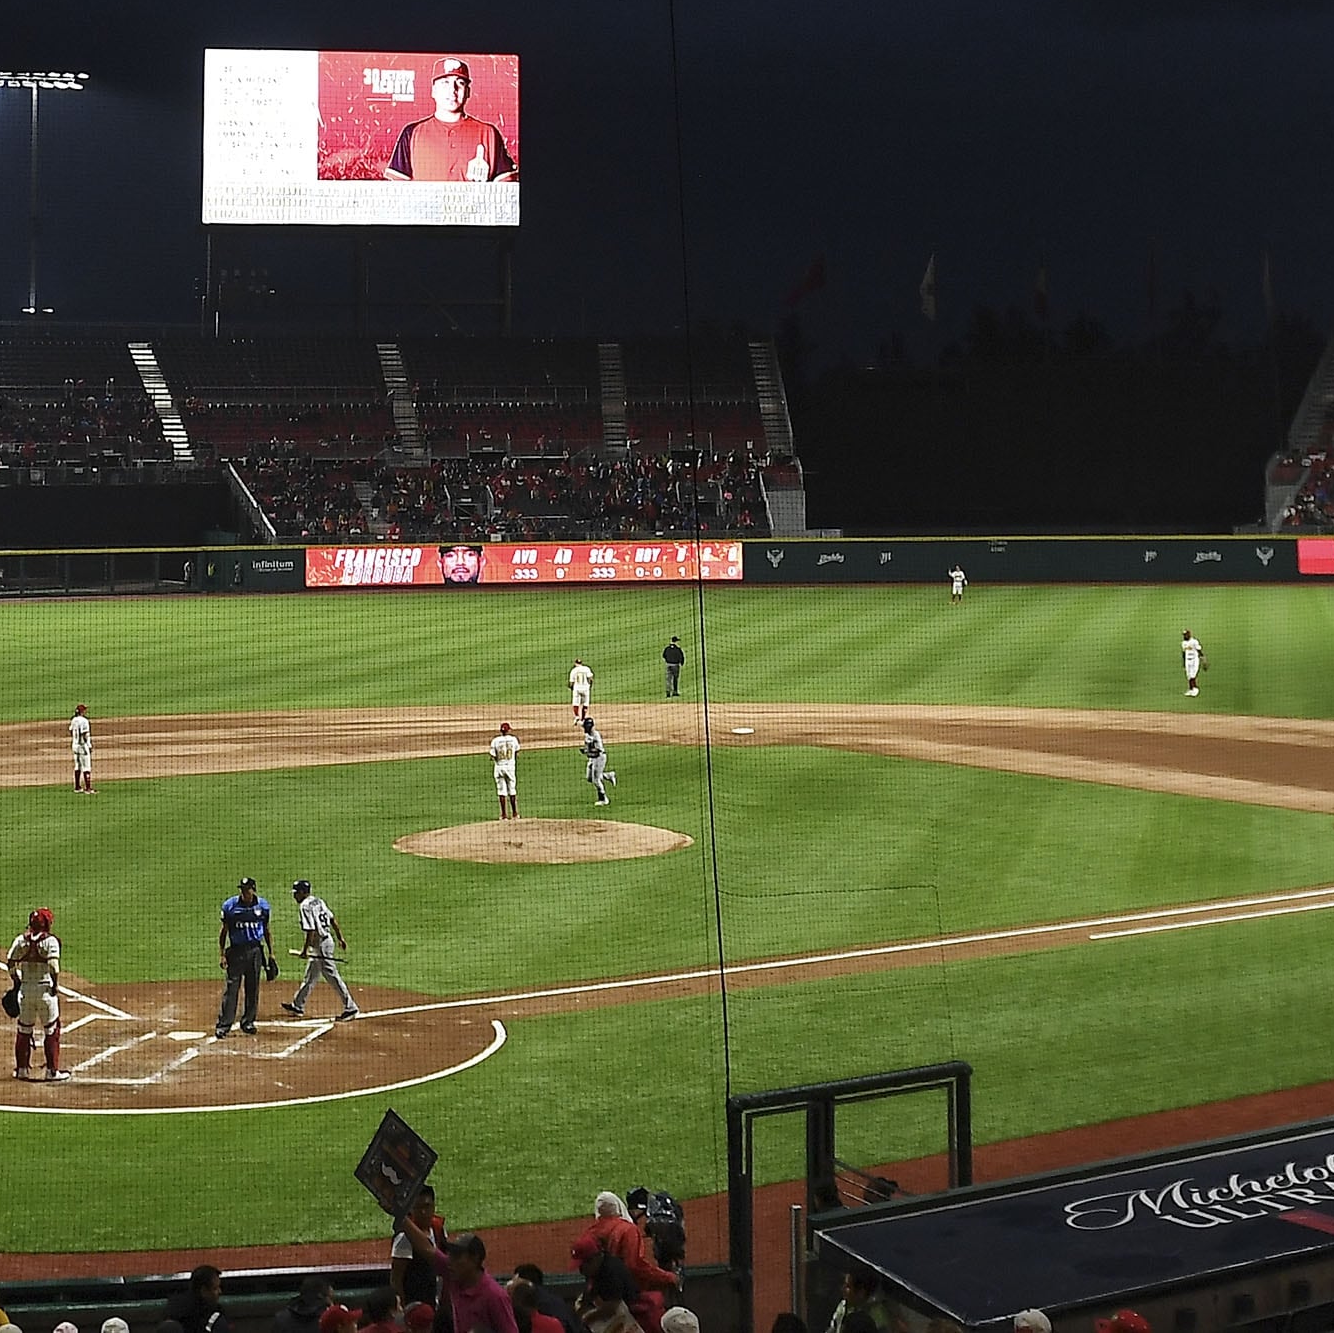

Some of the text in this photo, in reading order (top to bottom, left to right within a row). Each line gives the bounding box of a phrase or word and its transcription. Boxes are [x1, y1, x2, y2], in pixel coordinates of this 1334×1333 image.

[335, 549, 421, 567] FRANCISCO
[512, 549, 538, 564] AVG
[343, 566, 412, 584] CORDOBA
[511, 568, 538, 579] .333
[589, 568, 615, 579] .333
